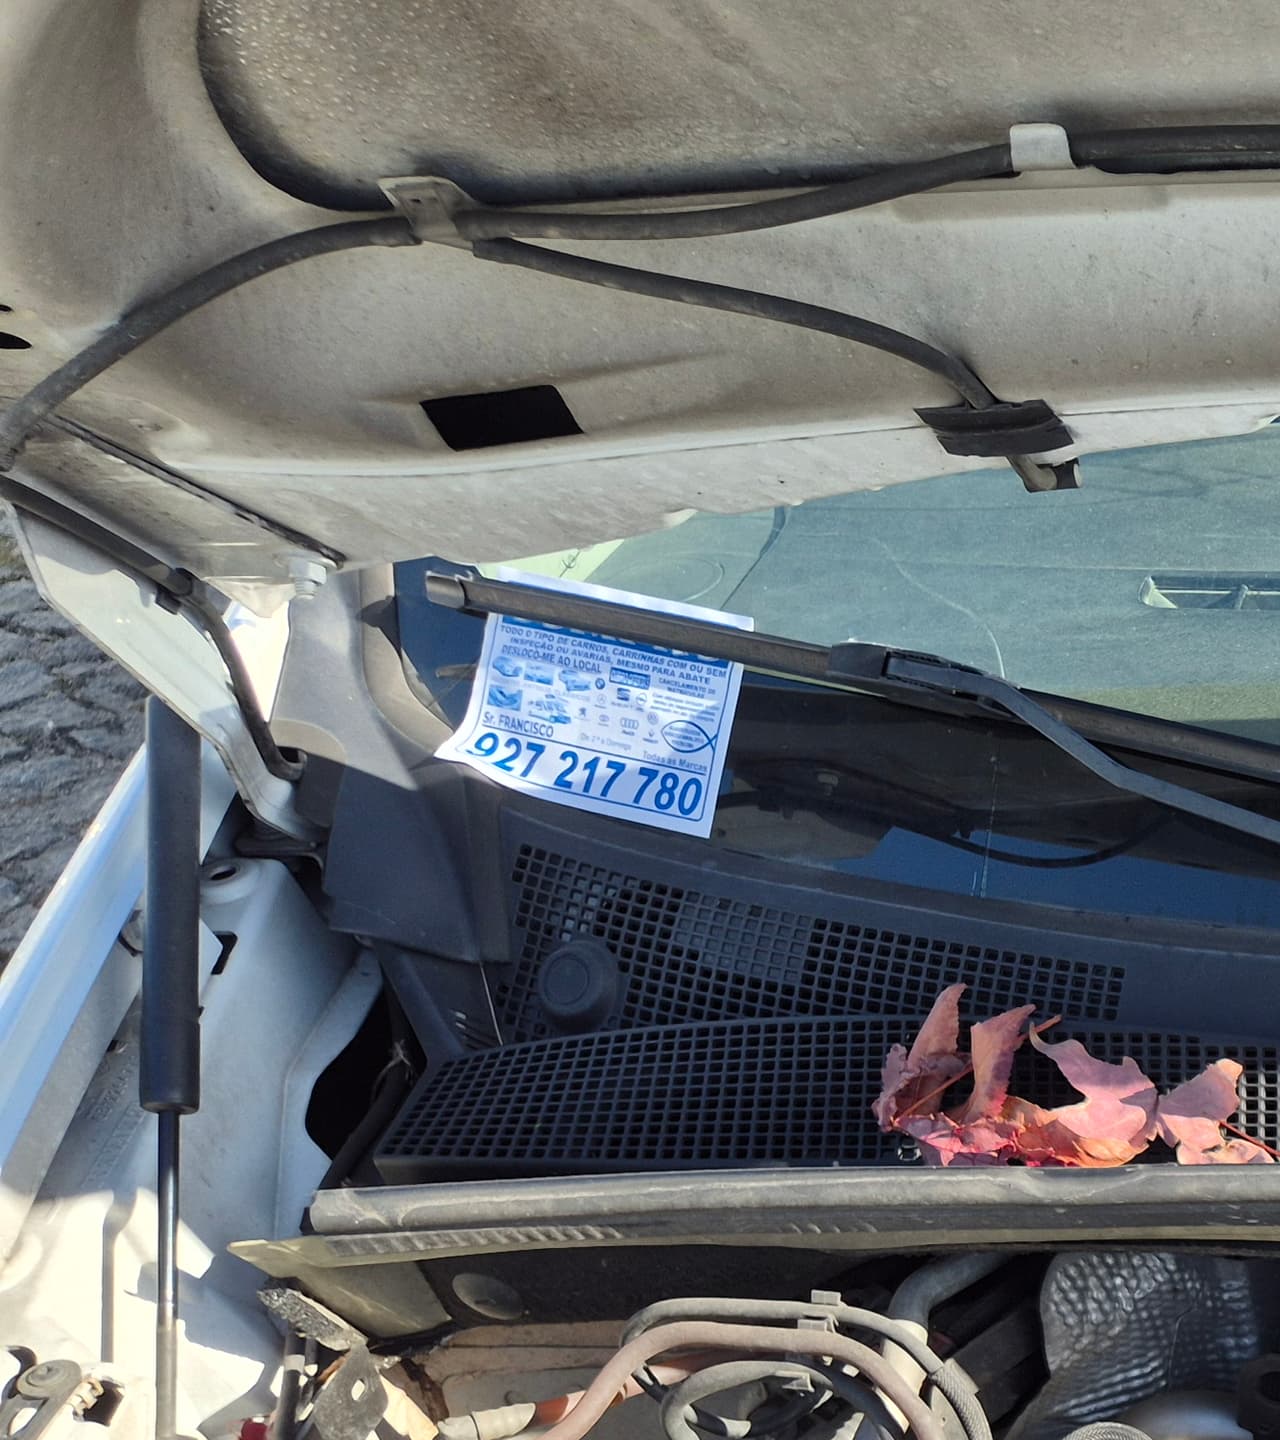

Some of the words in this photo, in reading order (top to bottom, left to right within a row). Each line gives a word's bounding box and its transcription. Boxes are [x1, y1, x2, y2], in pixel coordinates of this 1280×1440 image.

[500, 624, 525, 637] TODO
[534, 631, 556, 643] TIPO
[556, 635, 569, 645] DE
[612, 647, 665, 667] CARRINHAS
[666, 659, 687, 670] COM
[689, 662, 704, 673] OU
[706, 667, 727, 679] SEM
[556, 646, 569, 655] OU
[616, 658, 650, 671] MESMO
[651, 665, 676, 677] PARA
[679, 671, 711, 685] ABATE
[557, 655, 571, 667] AO
[573, 658, 601, 673] LOCAL
[482, 712, 496, 726] Sr.
[498, 714, 554, 738] FRANCISCO
[464, 732, 547, 778] 927
[553, 749, 626, 798] 217
[631, 768, 703, 817] 780
[643, 750, 665, 764] Todas
[666, 755, 677, 765] as
[678, 757, 708, 772] Marcas
